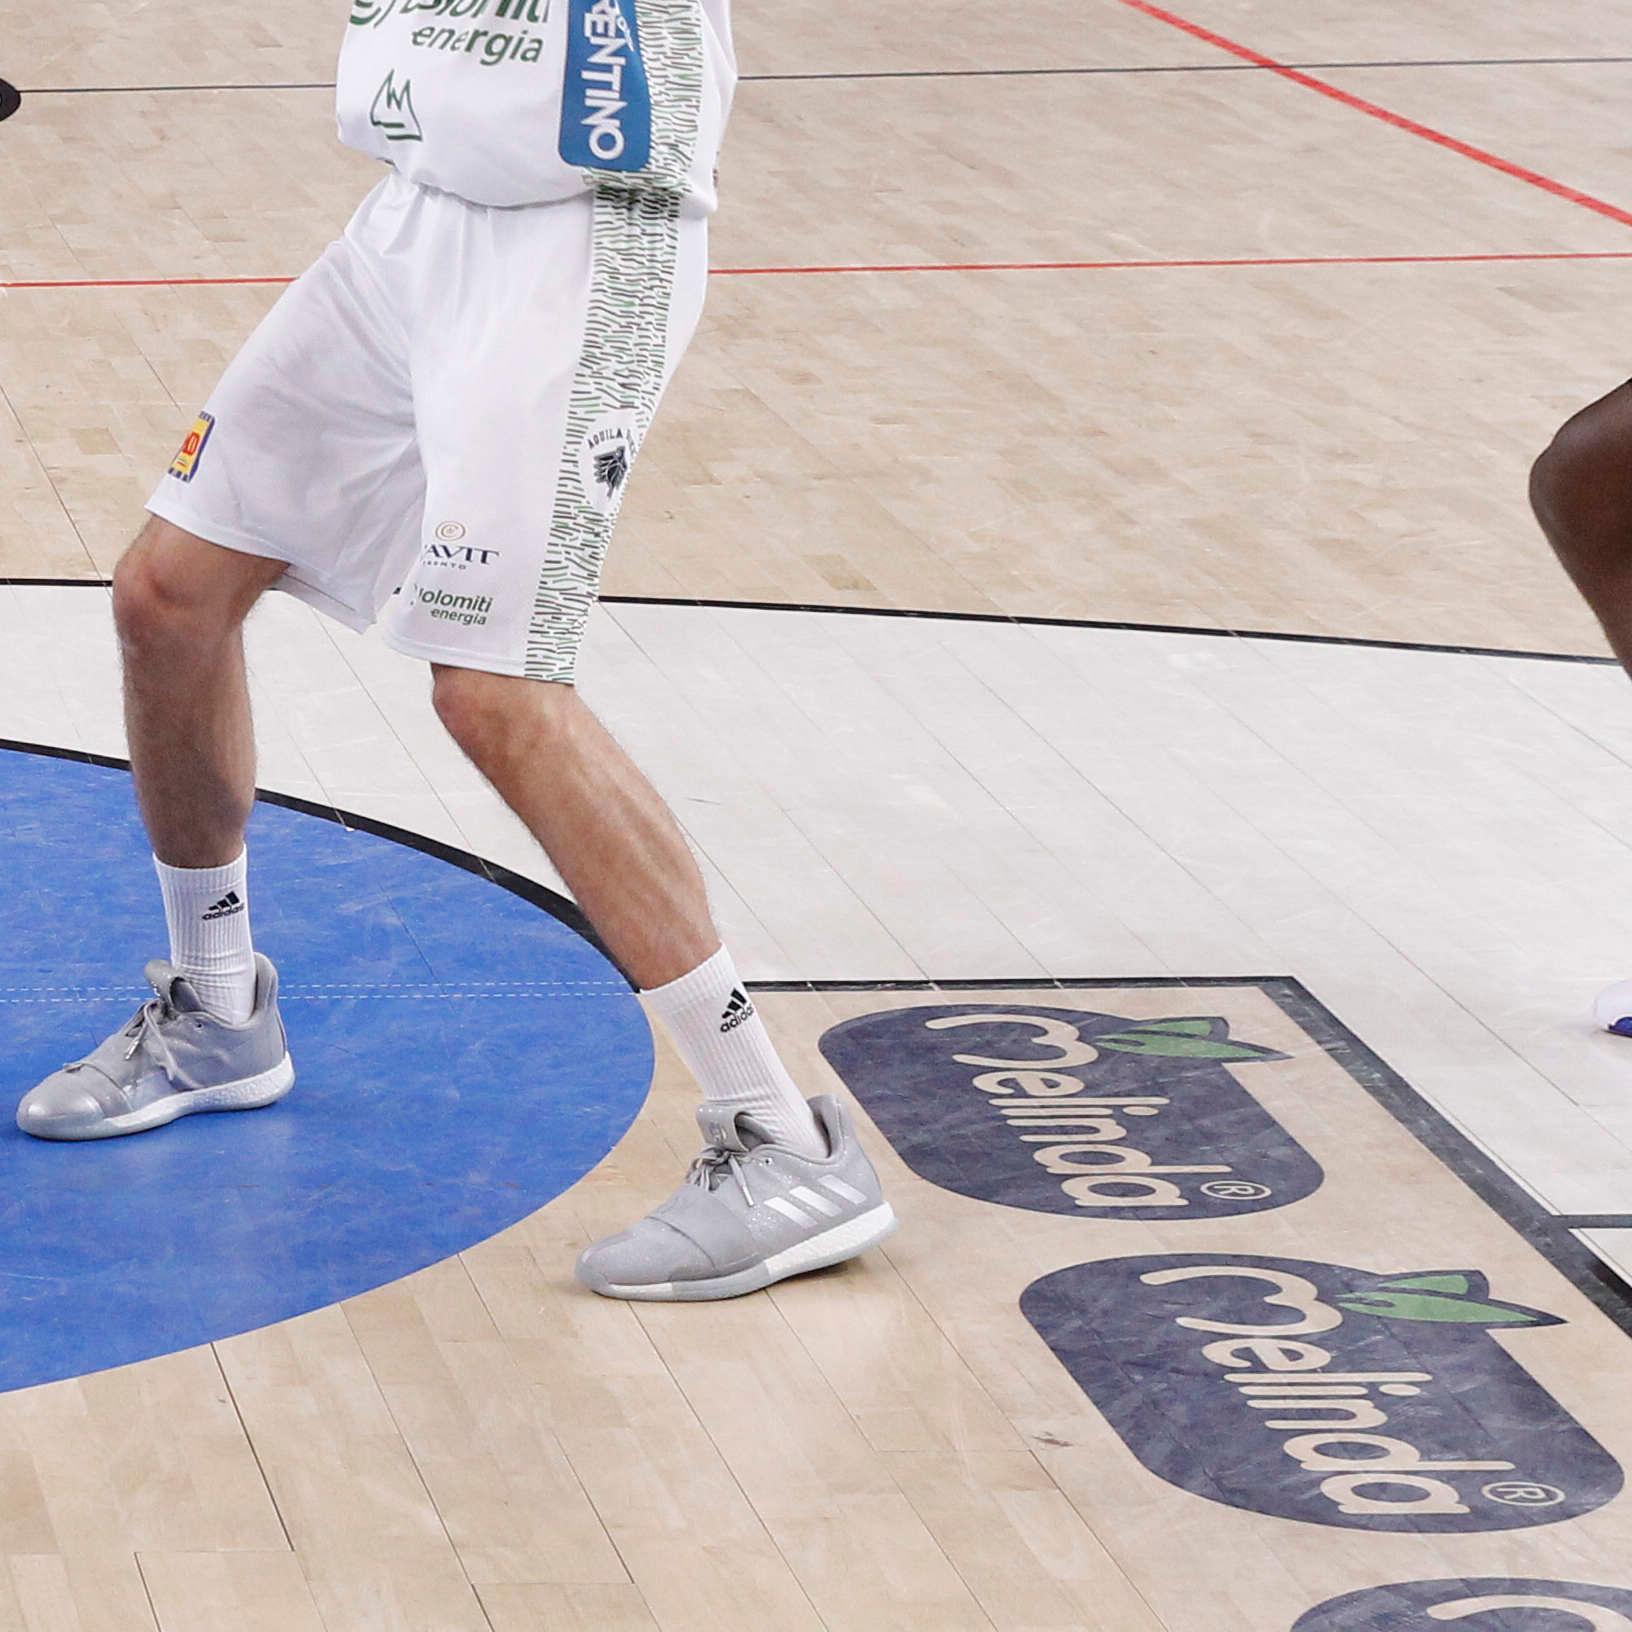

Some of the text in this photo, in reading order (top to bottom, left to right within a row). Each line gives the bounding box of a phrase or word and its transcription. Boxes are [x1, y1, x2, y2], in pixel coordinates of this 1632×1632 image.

[411, 25, 545, 67] energia
[424, 544, 500, 565] AVIT
[430, 607, 488, 627] energia
